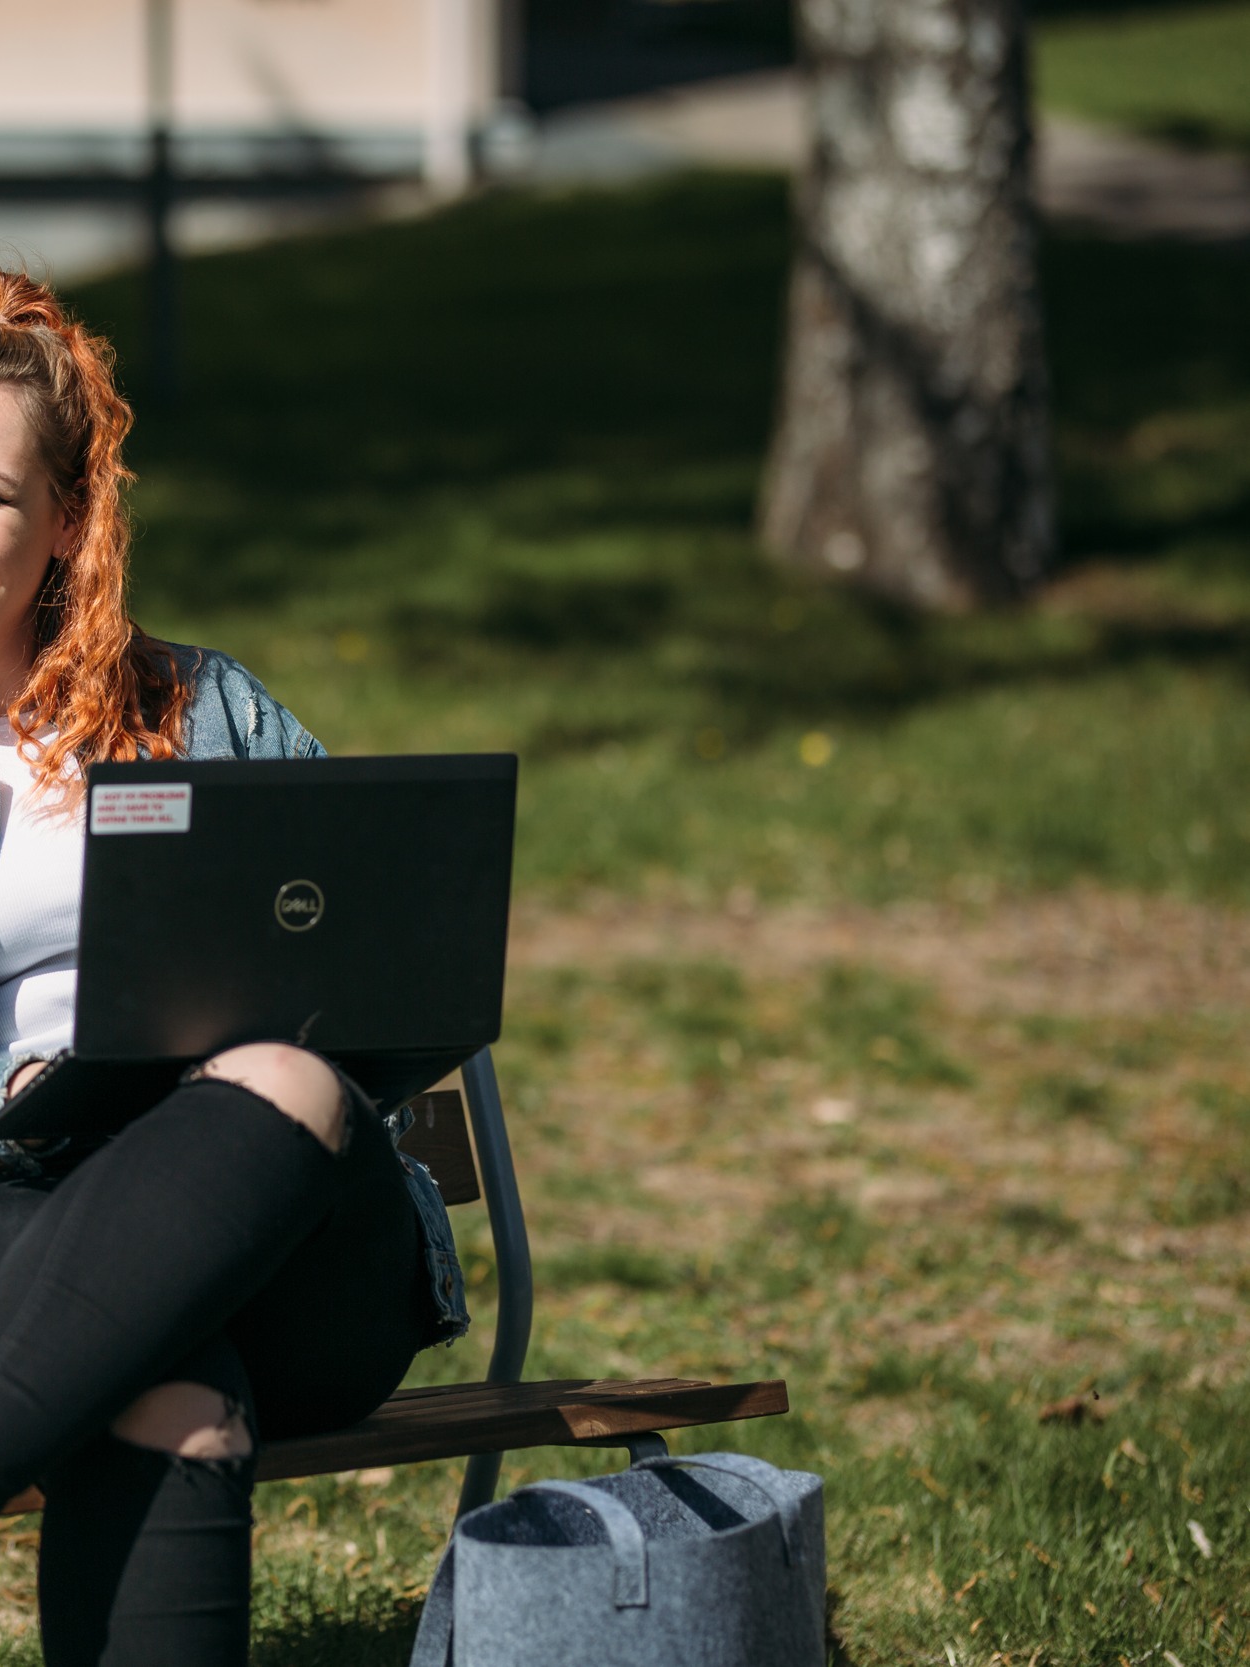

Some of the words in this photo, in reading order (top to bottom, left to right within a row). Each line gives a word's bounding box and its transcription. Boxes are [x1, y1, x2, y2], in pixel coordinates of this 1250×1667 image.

[138, 790, 187, 801] PROBLEMS
[125, 803, 149, 812] HAVE
[152, 803, 165, 812] TO
[130, 814, 156, 824] THEM
[281, 897, 317, 913] DELL
